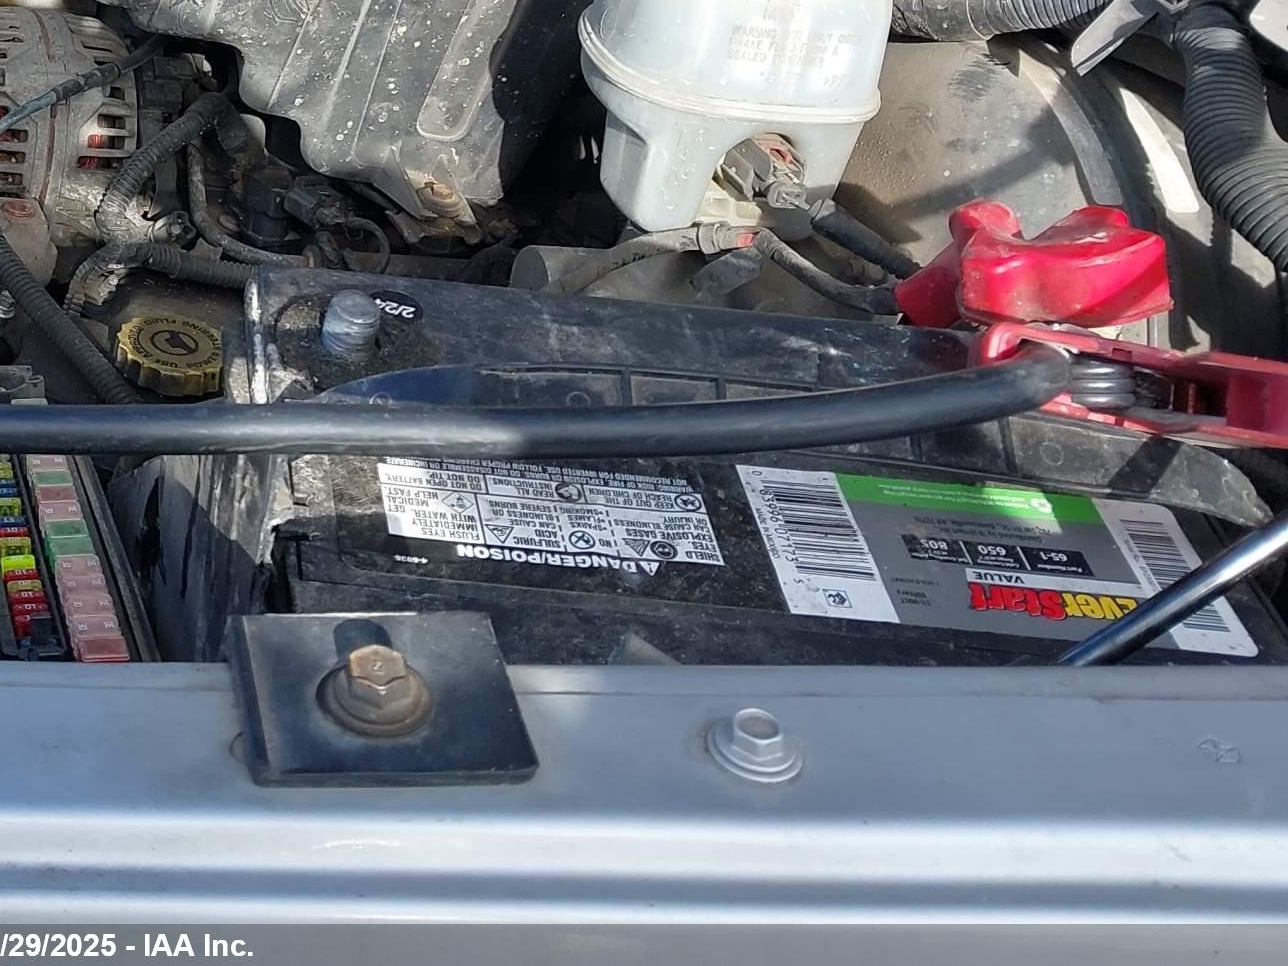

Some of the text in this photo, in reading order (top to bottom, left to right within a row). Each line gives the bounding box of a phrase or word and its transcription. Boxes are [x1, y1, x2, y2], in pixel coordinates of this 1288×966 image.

[424, 476, 446, 487] OPEN
[426, 470, 480, 483] DO NOT TIP.
[447, 479, 467, 489] NOT
[467, 481, 482, 490] DO
[382, 485, 439, 499] HELP FAST.
[513, 486, 555, 498] READ ALL
[631, 491, 643, 499] OF
[644, 492, 673, 502] REACH
[384, 494, 430, 507] MEDICAL
[603, 496, 674, 511] KEEP OUT OF THE
[386, 503, 406, 513] GET
[518, 502, 551, 512] SEVERE
[449, 511, 476, 523] WITH
[491, 508, 553, 521] BLINDNESS OR
[411, 517, 478, 532] IMMEDIATELY
[508, 518, 556, 529] CAN CAUSE
[612, 518, 710, 532] CAN CAUSE BLINDNESS
[420, 526, 480, 540] FLUSH EYES
[533, 528, 558, 539] ACID
[624, 528, 713, 542] EXPLOSIVE GASES
[511, 536, 561, 547] SULFURIC
[596, 538, 611, 547] NO
[773, 525, 799, 565] 07173
[684, 549, 719, 561] SHIELD
[976, 544, 1007, 555] 650
[1039, 550, 1068, 561] 65-1
[455, 544, 638, 573] DANGER/POISON
[969, 569, 1025, 583] VALUE
